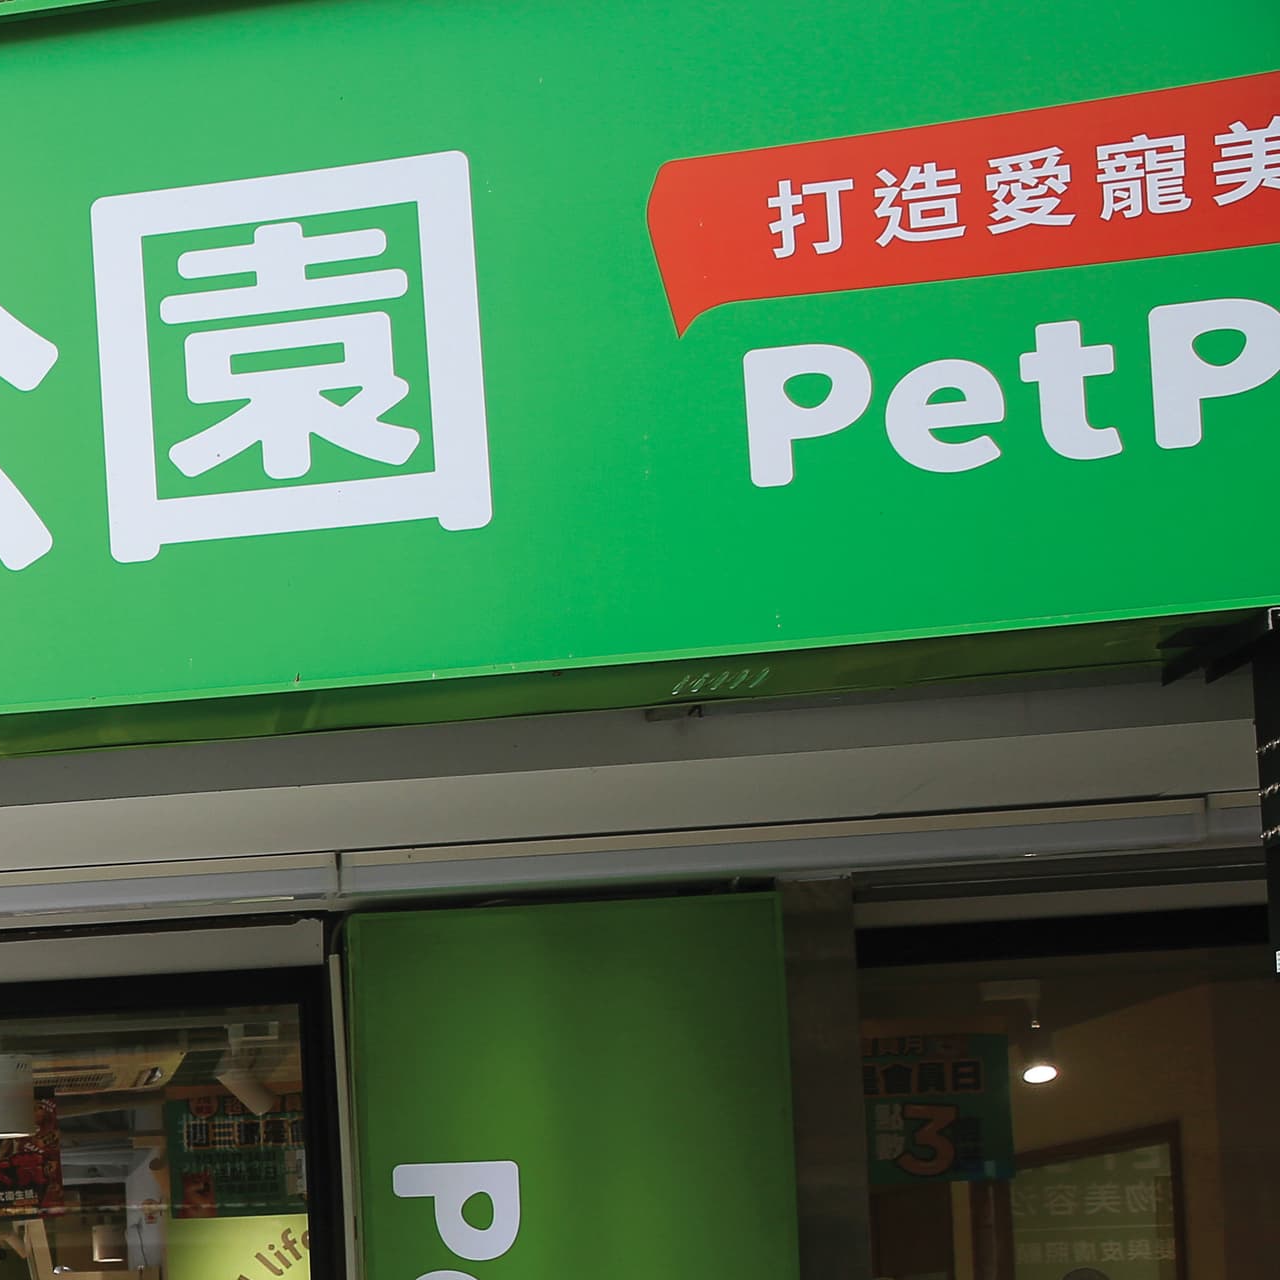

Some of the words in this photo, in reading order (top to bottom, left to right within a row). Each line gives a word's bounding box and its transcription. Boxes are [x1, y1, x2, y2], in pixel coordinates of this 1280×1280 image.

[766, 115, 1280, 259] 打造愛寵美
[743, 298, 1280, 487] PetP
